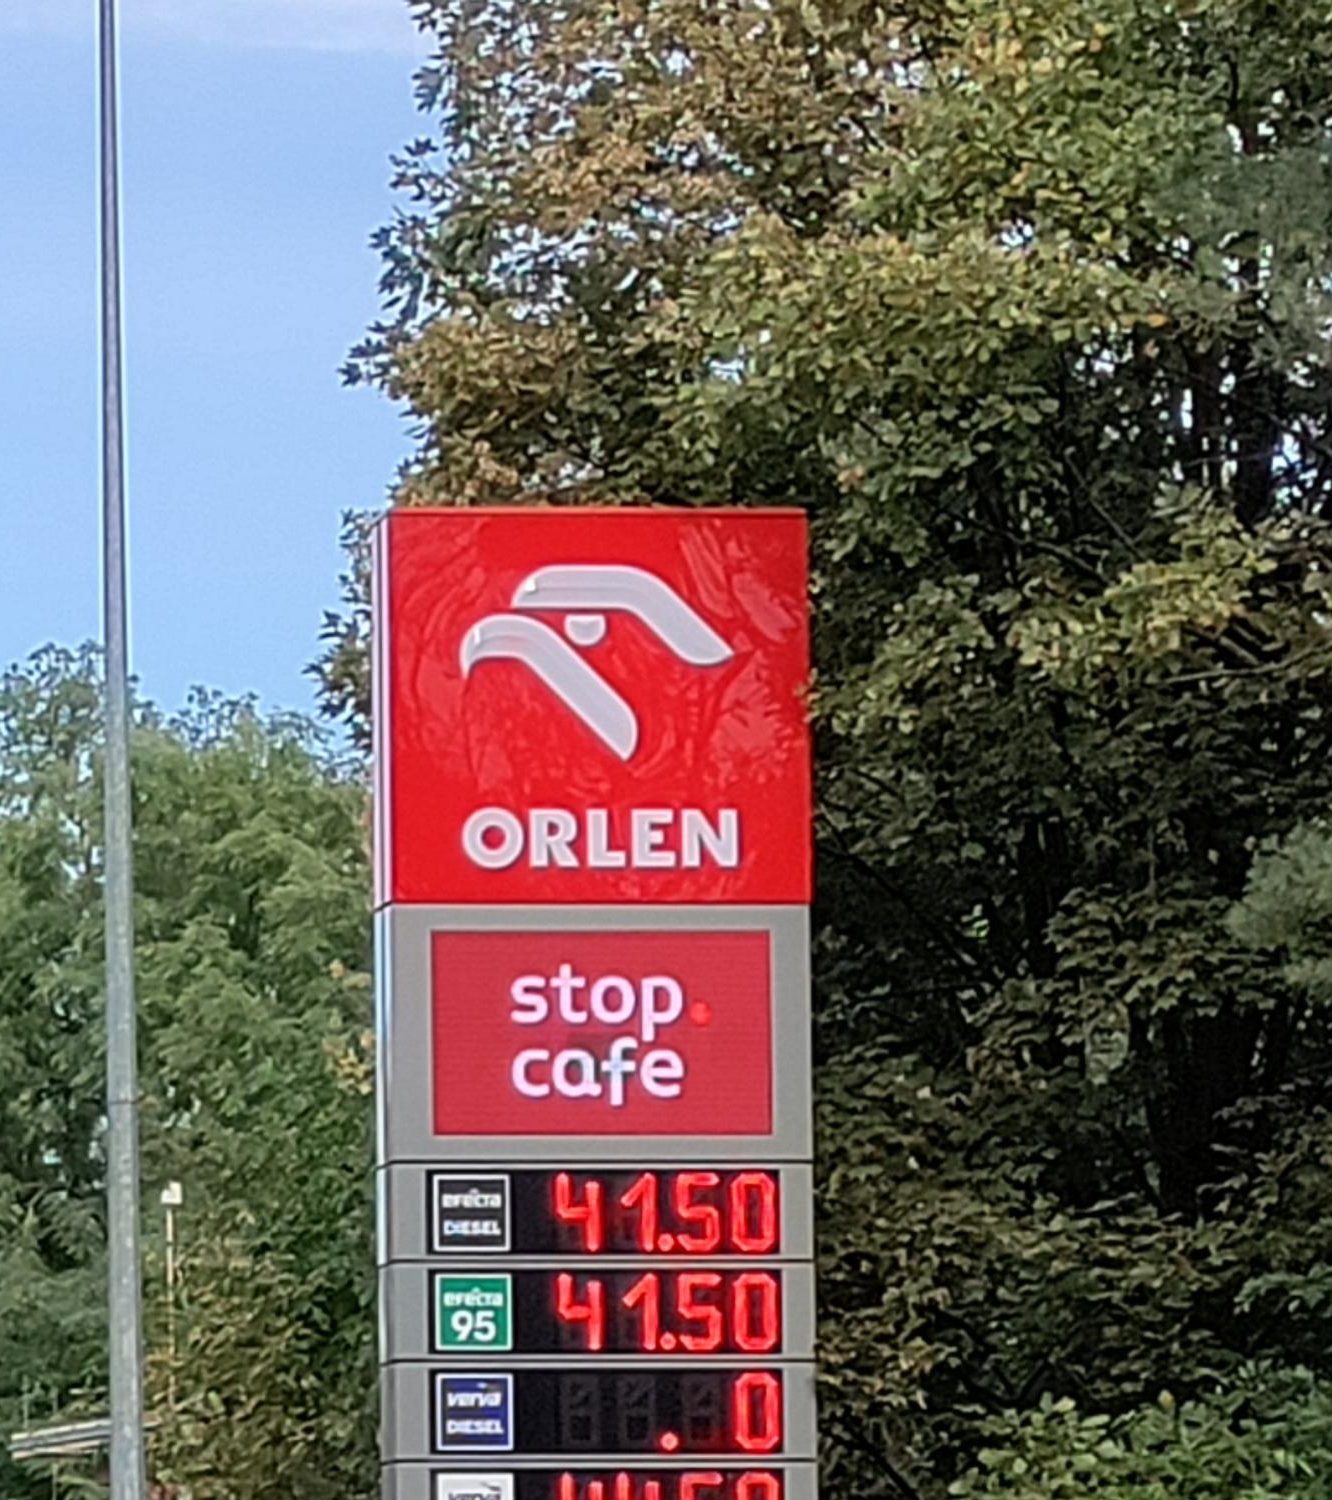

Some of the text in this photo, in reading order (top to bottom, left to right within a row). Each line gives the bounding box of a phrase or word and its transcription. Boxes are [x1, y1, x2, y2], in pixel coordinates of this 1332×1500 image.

[462, 807, 738, 869] ORLEN
[512, 1036, 684, 1106] cafe
[444, 1220, 501, 1236] DIESEL
[554, 1173, 775, 1252] 41.50
[451, 1310, 496, 1342] 95
[557, 1273, 777, 1351] 41.50
